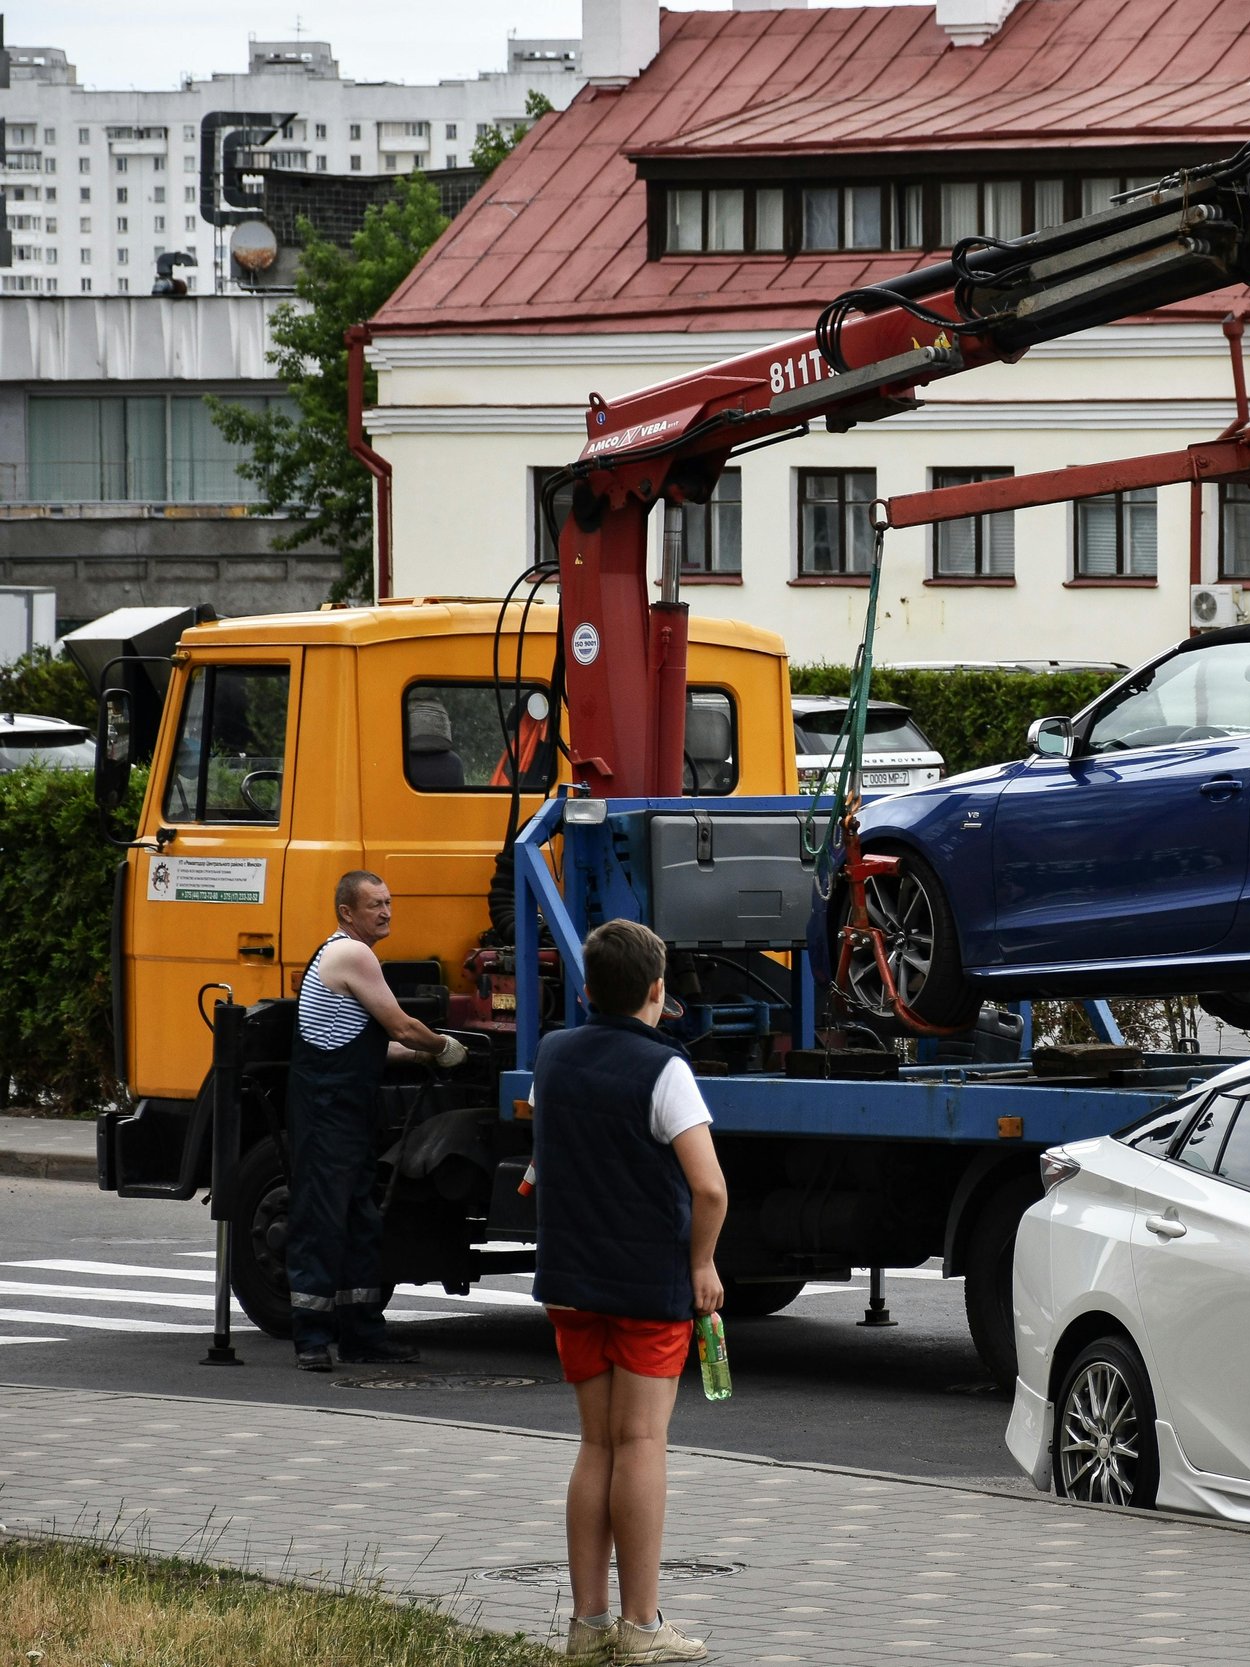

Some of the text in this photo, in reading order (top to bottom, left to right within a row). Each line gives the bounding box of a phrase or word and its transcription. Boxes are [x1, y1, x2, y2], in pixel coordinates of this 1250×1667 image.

[770, 348, 822, 394] 811T
[586, 436, 619, 454] AMCO
[640, 420, 667, 437] VEBA
[888, 772, 907, 783] MP-7
